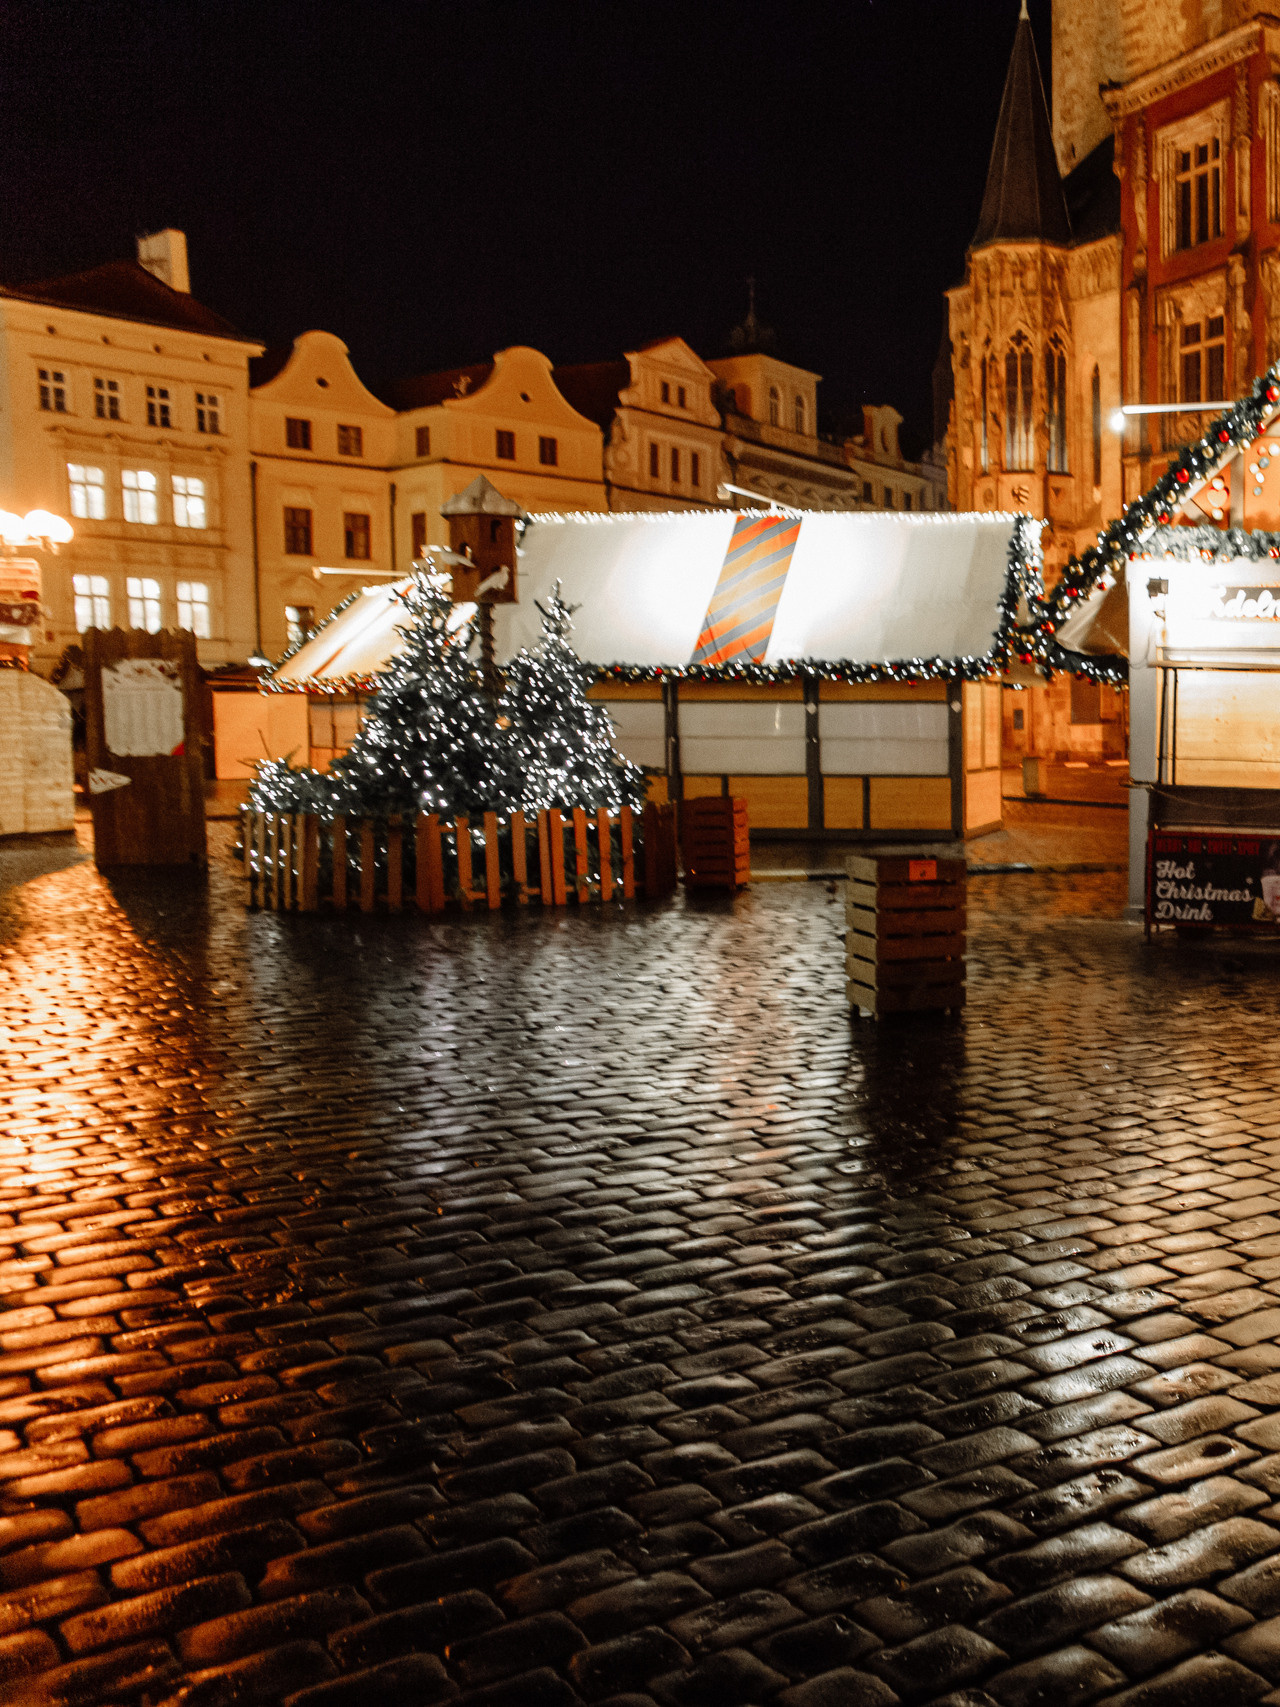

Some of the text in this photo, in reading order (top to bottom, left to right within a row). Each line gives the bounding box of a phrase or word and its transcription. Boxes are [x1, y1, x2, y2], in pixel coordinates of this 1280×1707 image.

[1155, 859, 1196, 880] Hot
[1155, 880, 1255, 902] Christmas
[1154, 901, 1214, 921] Drink
